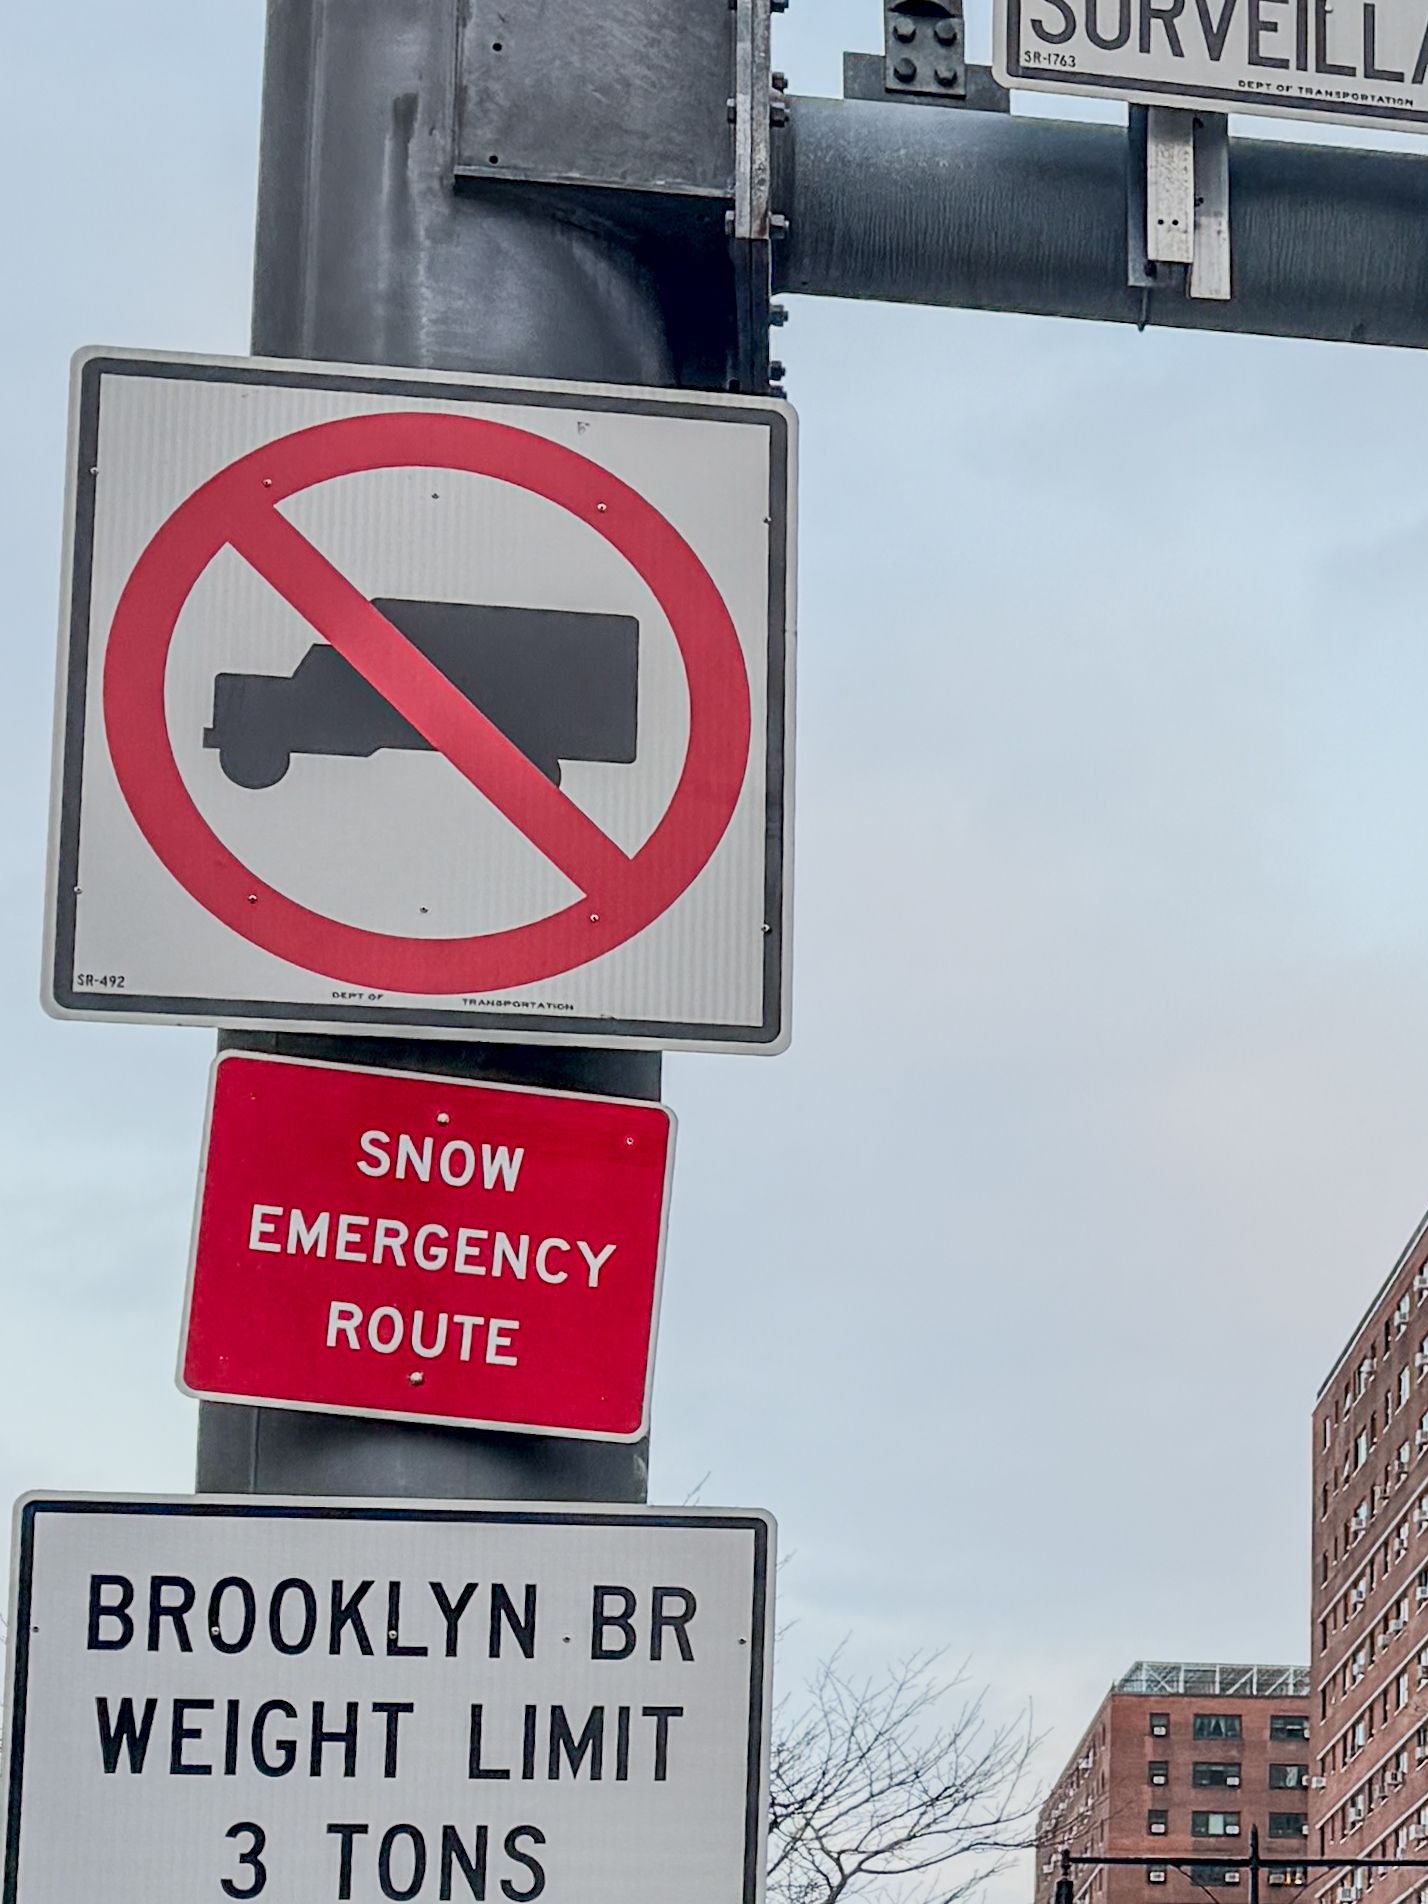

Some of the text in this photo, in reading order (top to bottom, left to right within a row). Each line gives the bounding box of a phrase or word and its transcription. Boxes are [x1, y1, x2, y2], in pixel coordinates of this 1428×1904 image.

[1023, 50, 1077, 69] SR-1763
[1237, 79, 1414, 107] DEPT OF TRANSPORTATION
[76, 973, 126, 988] SR-492
[331, 991, 575, 1011] DEPT OF TRANSPORTATION
[357, 1130, 524, 1191] SNOW
[249, 1204, 616, 1287] EMERGENCY
[327, 1301, 519, 1366] ROUTE
[87, 1575, 696, 1661] BROOKLYN BR
[96, 1697, 683, 1781] WEIGHT LIMIT
[221, 1822, 546, 1902] 3 TONS
